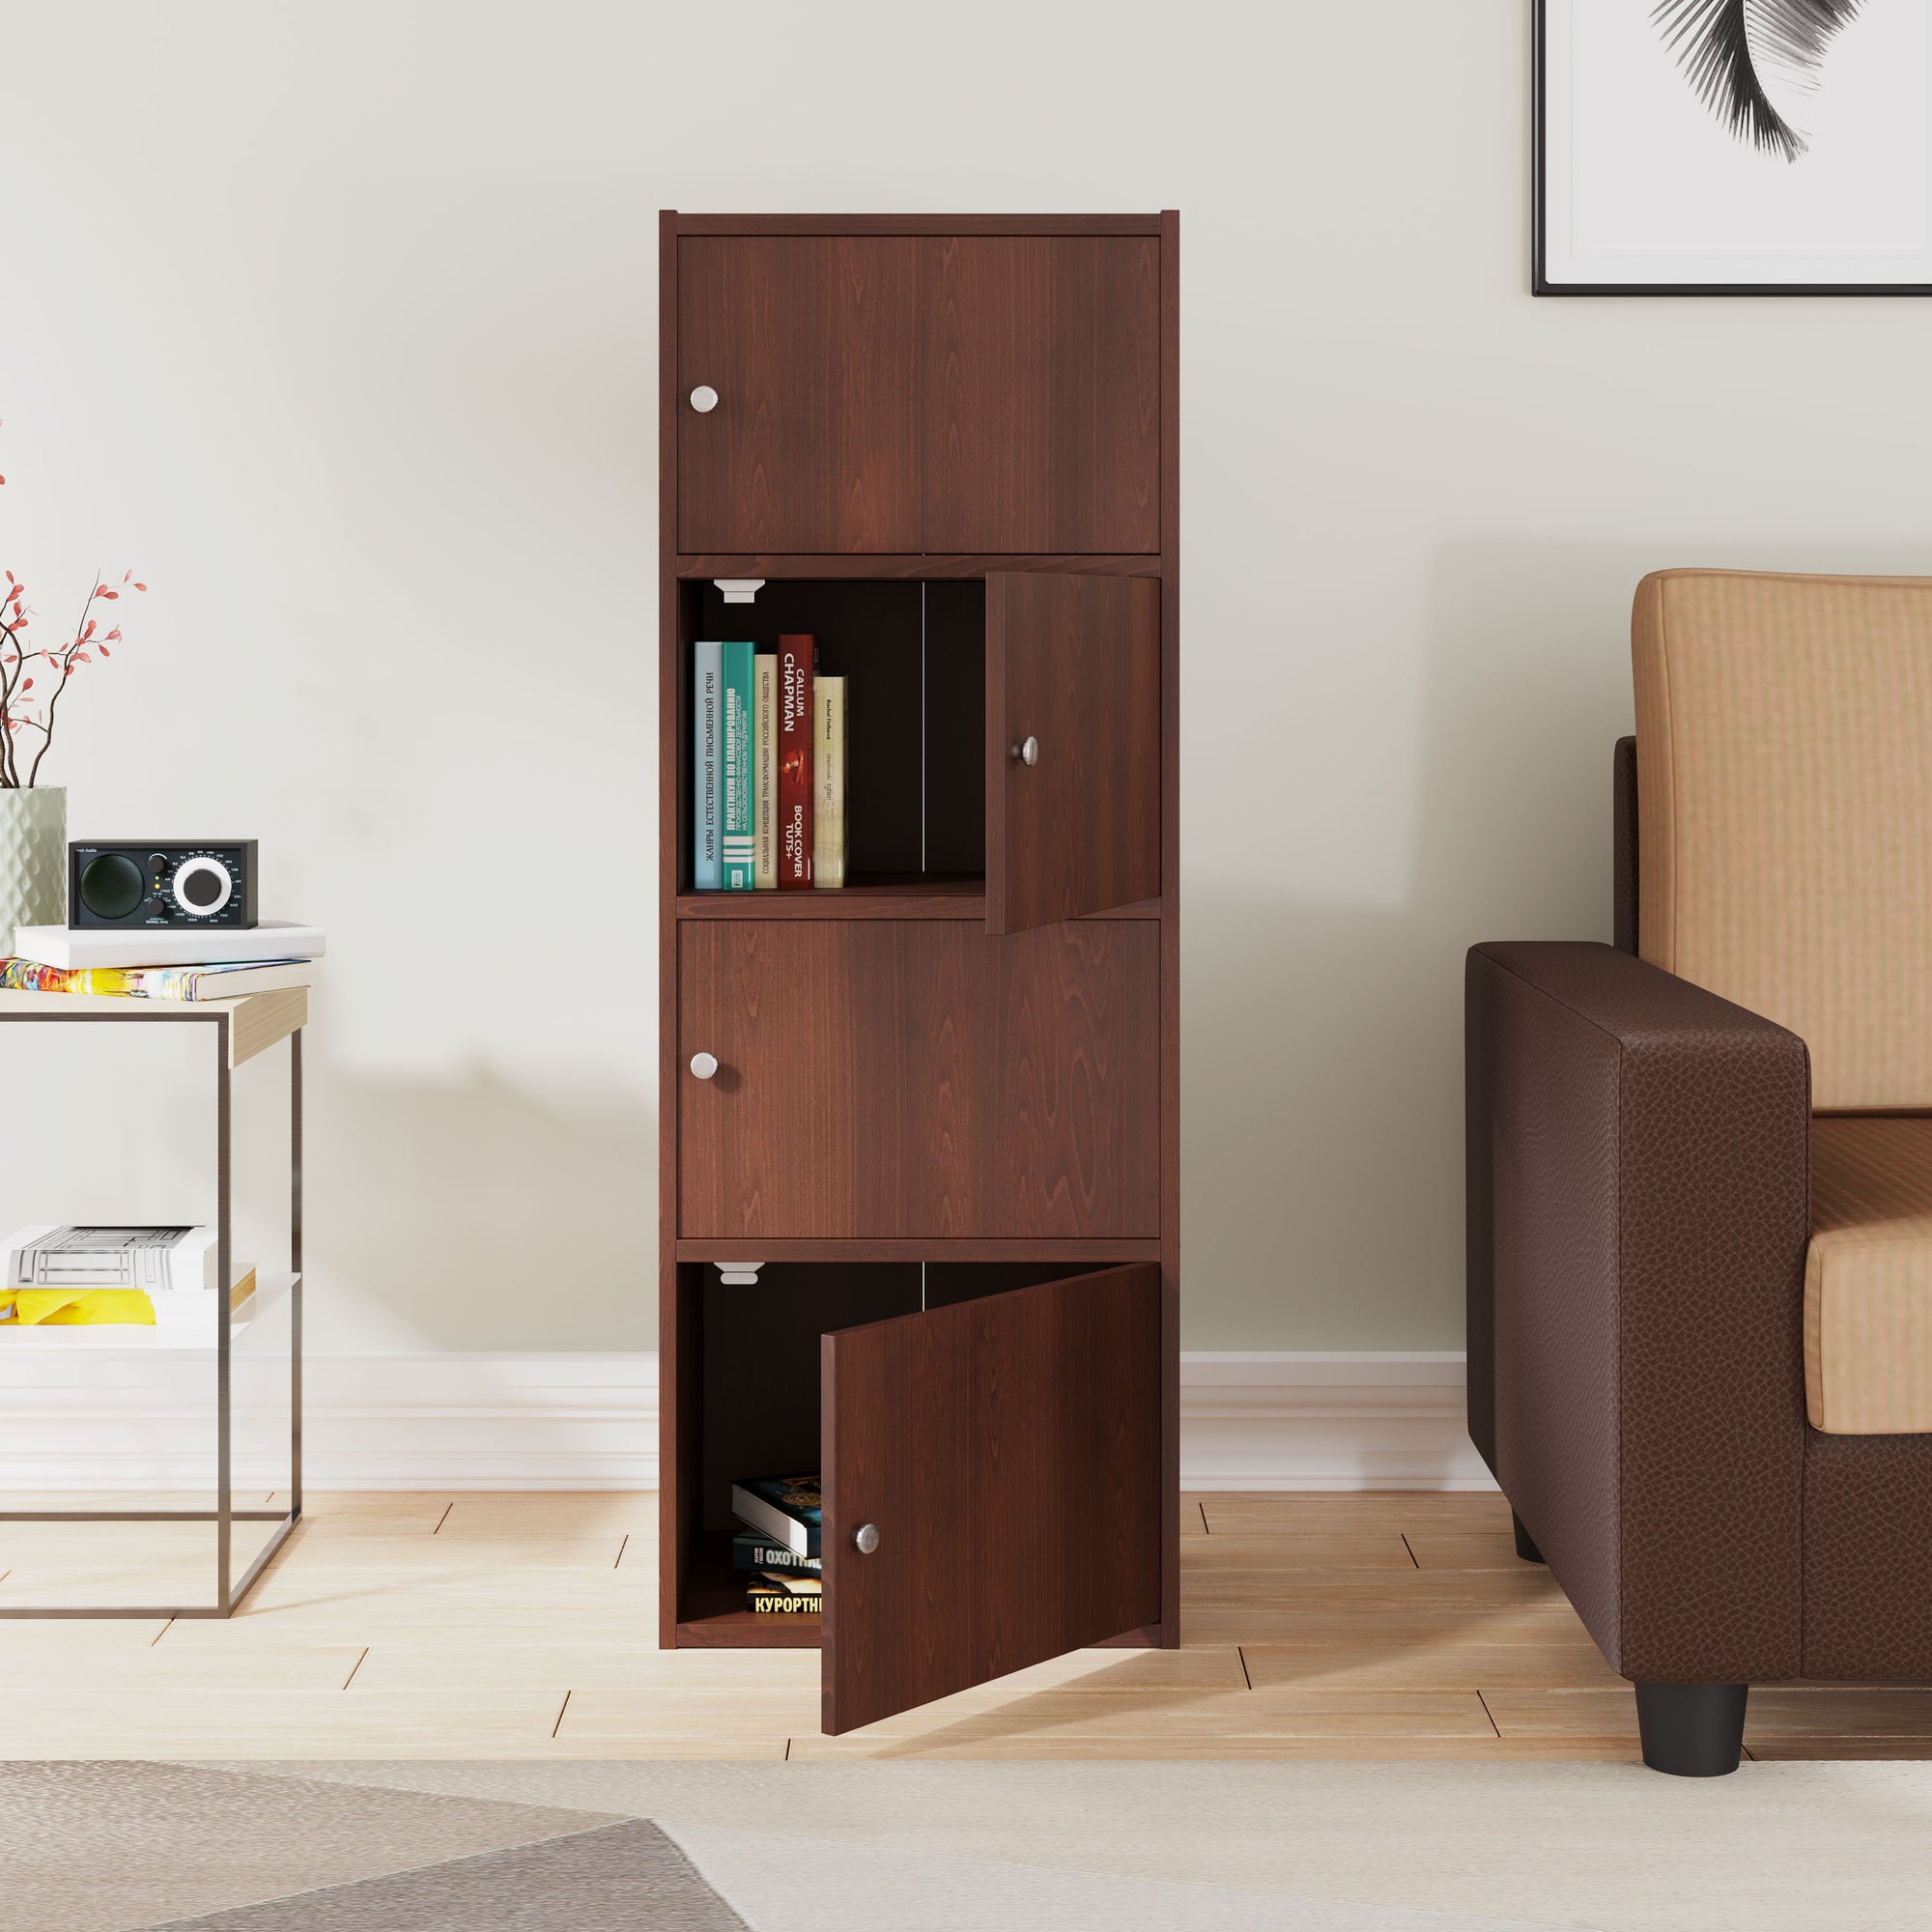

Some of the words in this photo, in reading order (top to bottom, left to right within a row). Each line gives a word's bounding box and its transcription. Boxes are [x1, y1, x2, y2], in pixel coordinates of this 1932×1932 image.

[706, 671, 715, 695] РЕЧИ
[783, 653, 794, 731] CHAPMAN
[796, 668, 805, 717] CALLUM
[705, 696, 715, 757] ПИСЬМЕННОЙ
[726, 688, 736, 762] ПЛАНИРОВАНИЮ
[761, 703, 770, 746] РОССИЙСКОГО
[726, 763, 736, 777] ПО
[705, 760, 715, 826] ЕСТЕСТВЕННОЙ
[726, 778, 736, 831] ПРАКТИКУМ
[785, 823, 794, 859] TUTS+
[794, 805, 803, 838] BOOK
[706, 829, 715, 862] ЖАНРЫ
[794, 838, 803, 878] COVER
